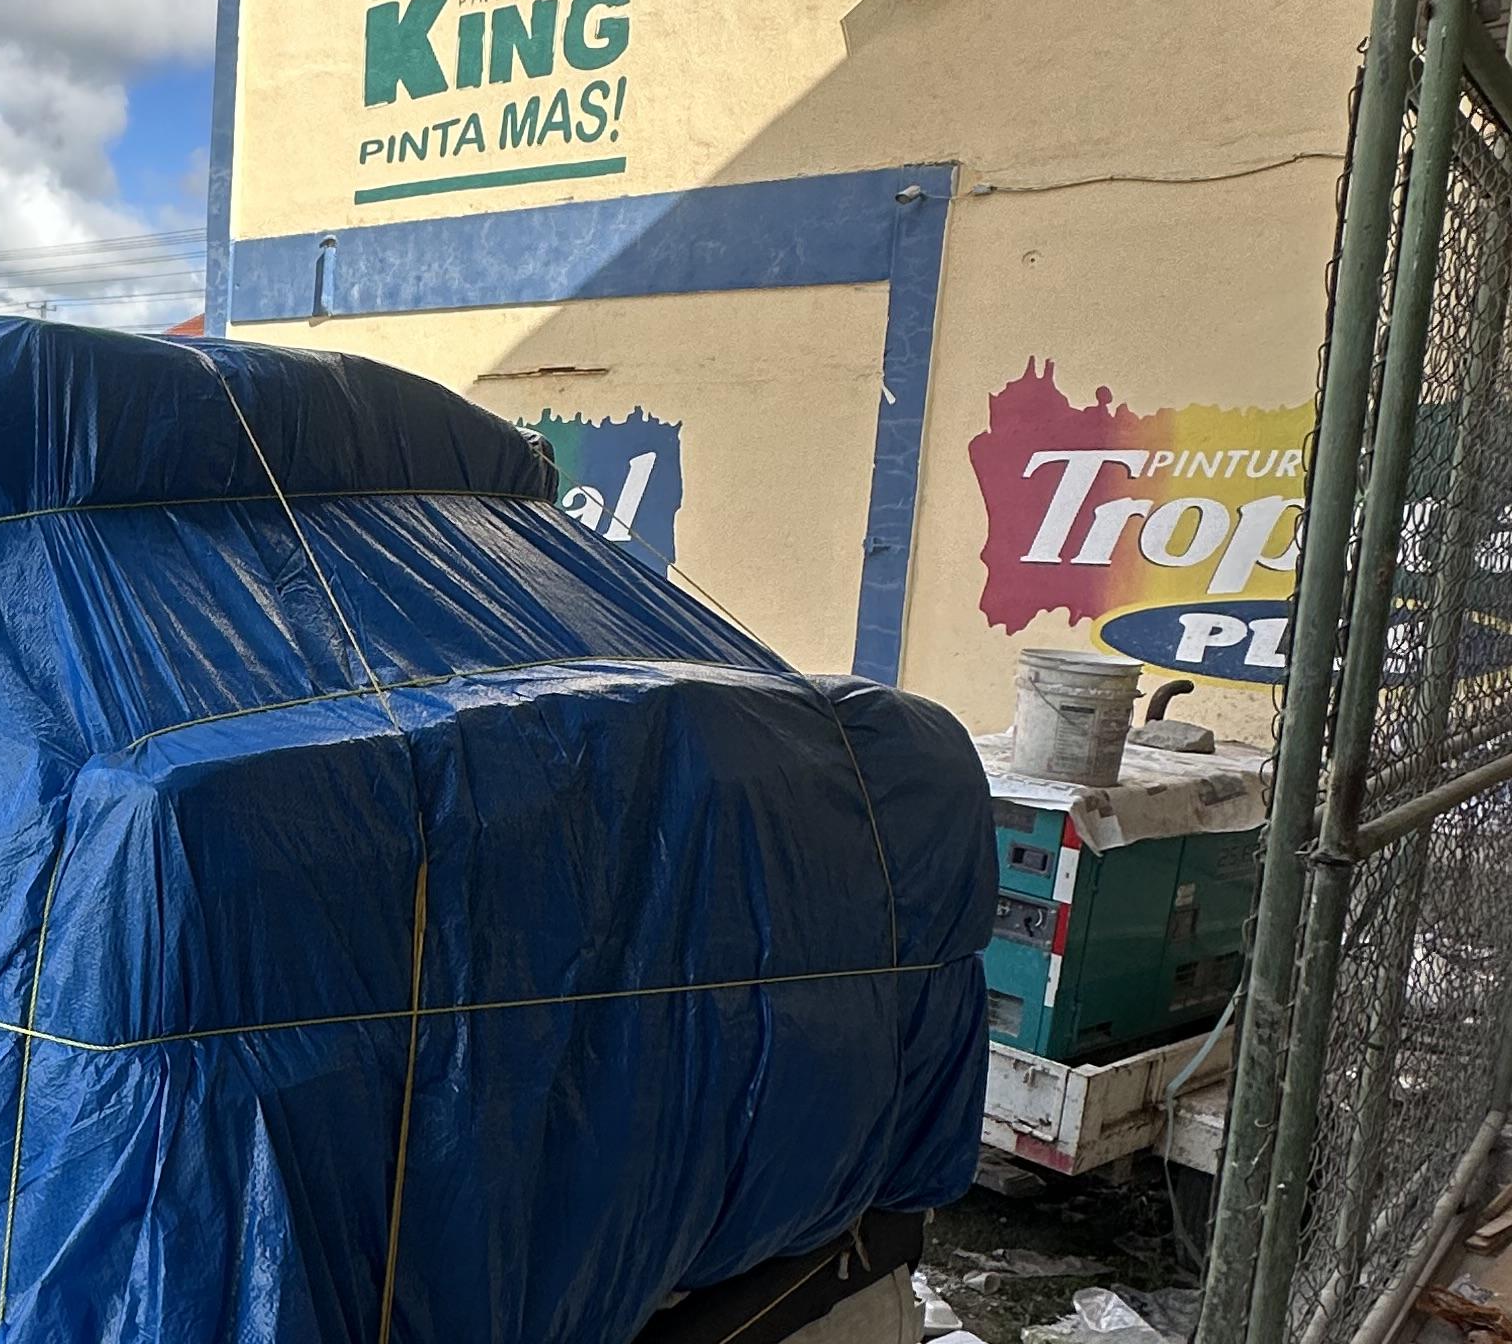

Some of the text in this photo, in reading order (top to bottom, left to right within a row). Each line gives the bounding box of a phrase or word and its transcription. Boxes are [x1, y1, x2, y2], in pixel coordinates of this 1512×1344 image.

[359, 76, 628, 165] PINTA MAS!
[1146, 447, 1304, 480] PINTUR
[1019, 449, 1307, 595] Trop
